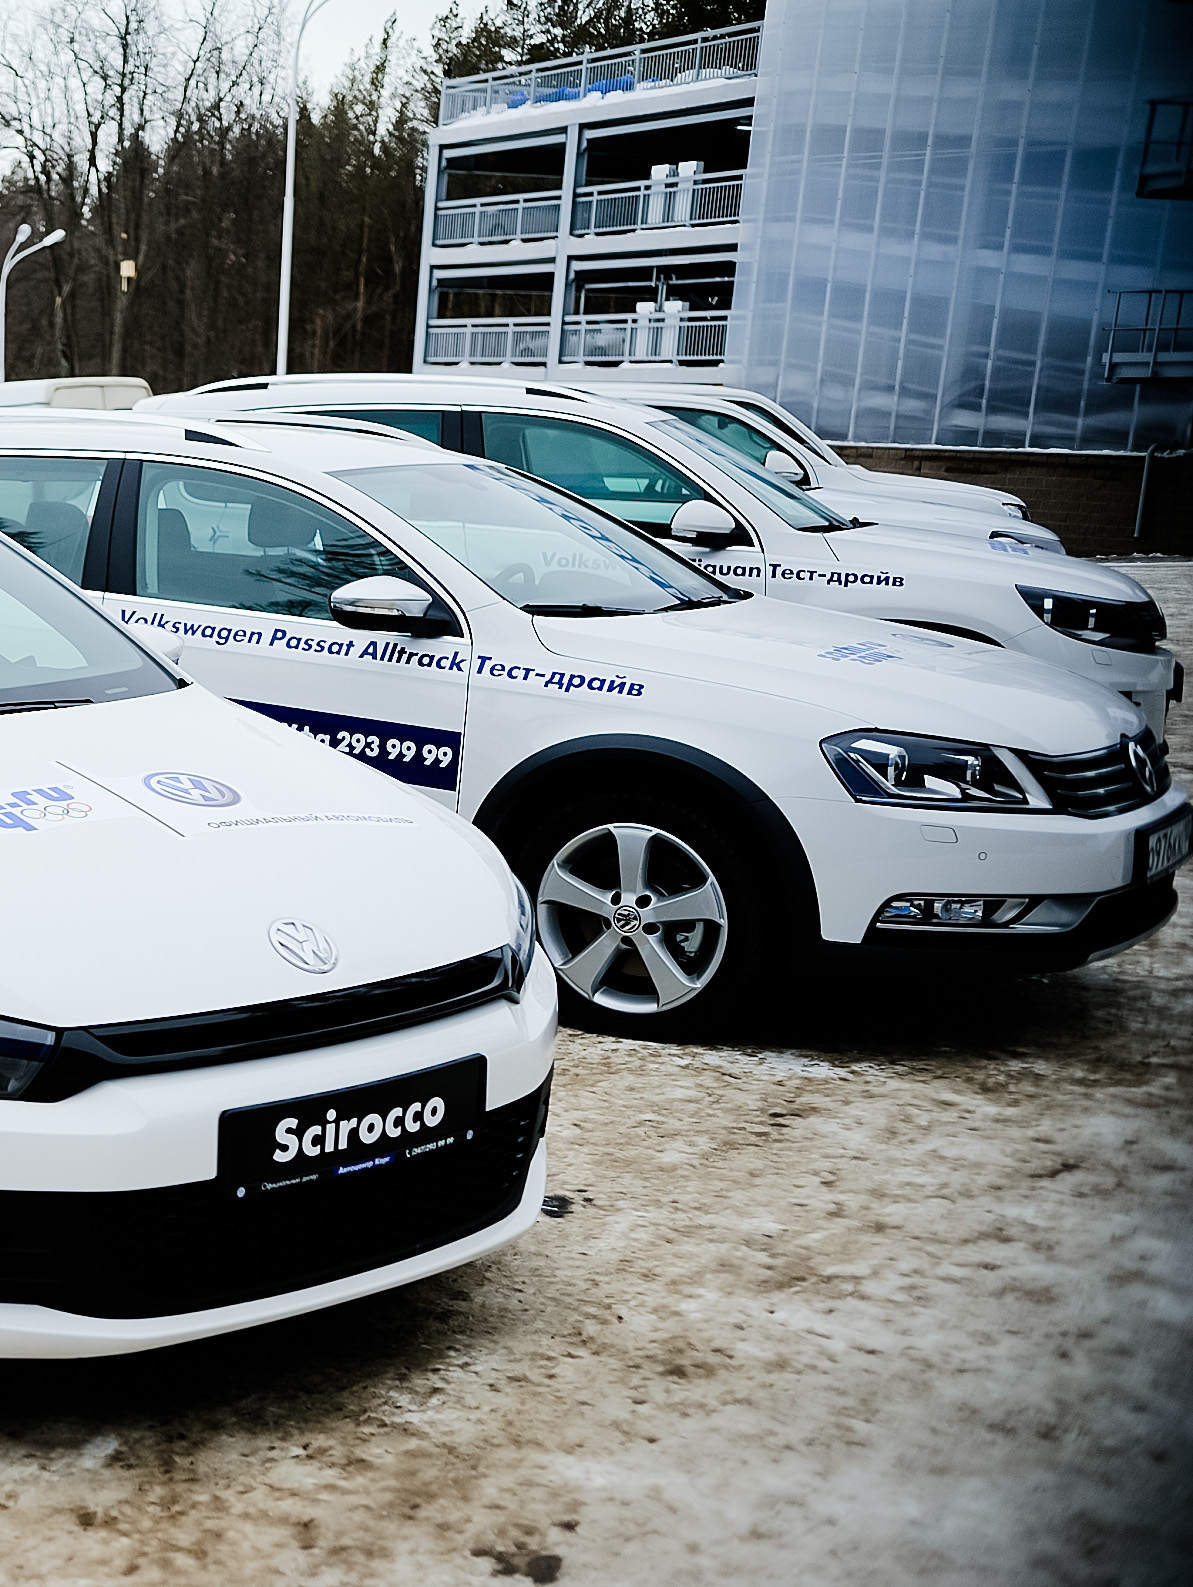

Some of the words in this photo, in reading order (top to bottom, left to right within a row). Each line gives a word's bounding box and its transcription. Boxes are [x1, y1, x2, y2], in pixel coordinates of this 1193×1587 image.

[688, 557, 761, 578] guan
[768, 563, 906, 588] Тест-драйв
[268, 628, 355, 657] Passat
[358, 640, 468, 673] Alltrack
[476, 655, 646, 697] Тест-драйв
[335, 731, 380, 758] 293
[386, 738, 416, 762] 99
[422, 744, 453, 768] 99
[207, 813, 324, 829] ОФИЦИАЛЬНЫЙ
[324, 813, 414, 824] АВТОМОБИЛЬ
[272, 1096, 446, 1163] Scirocco
